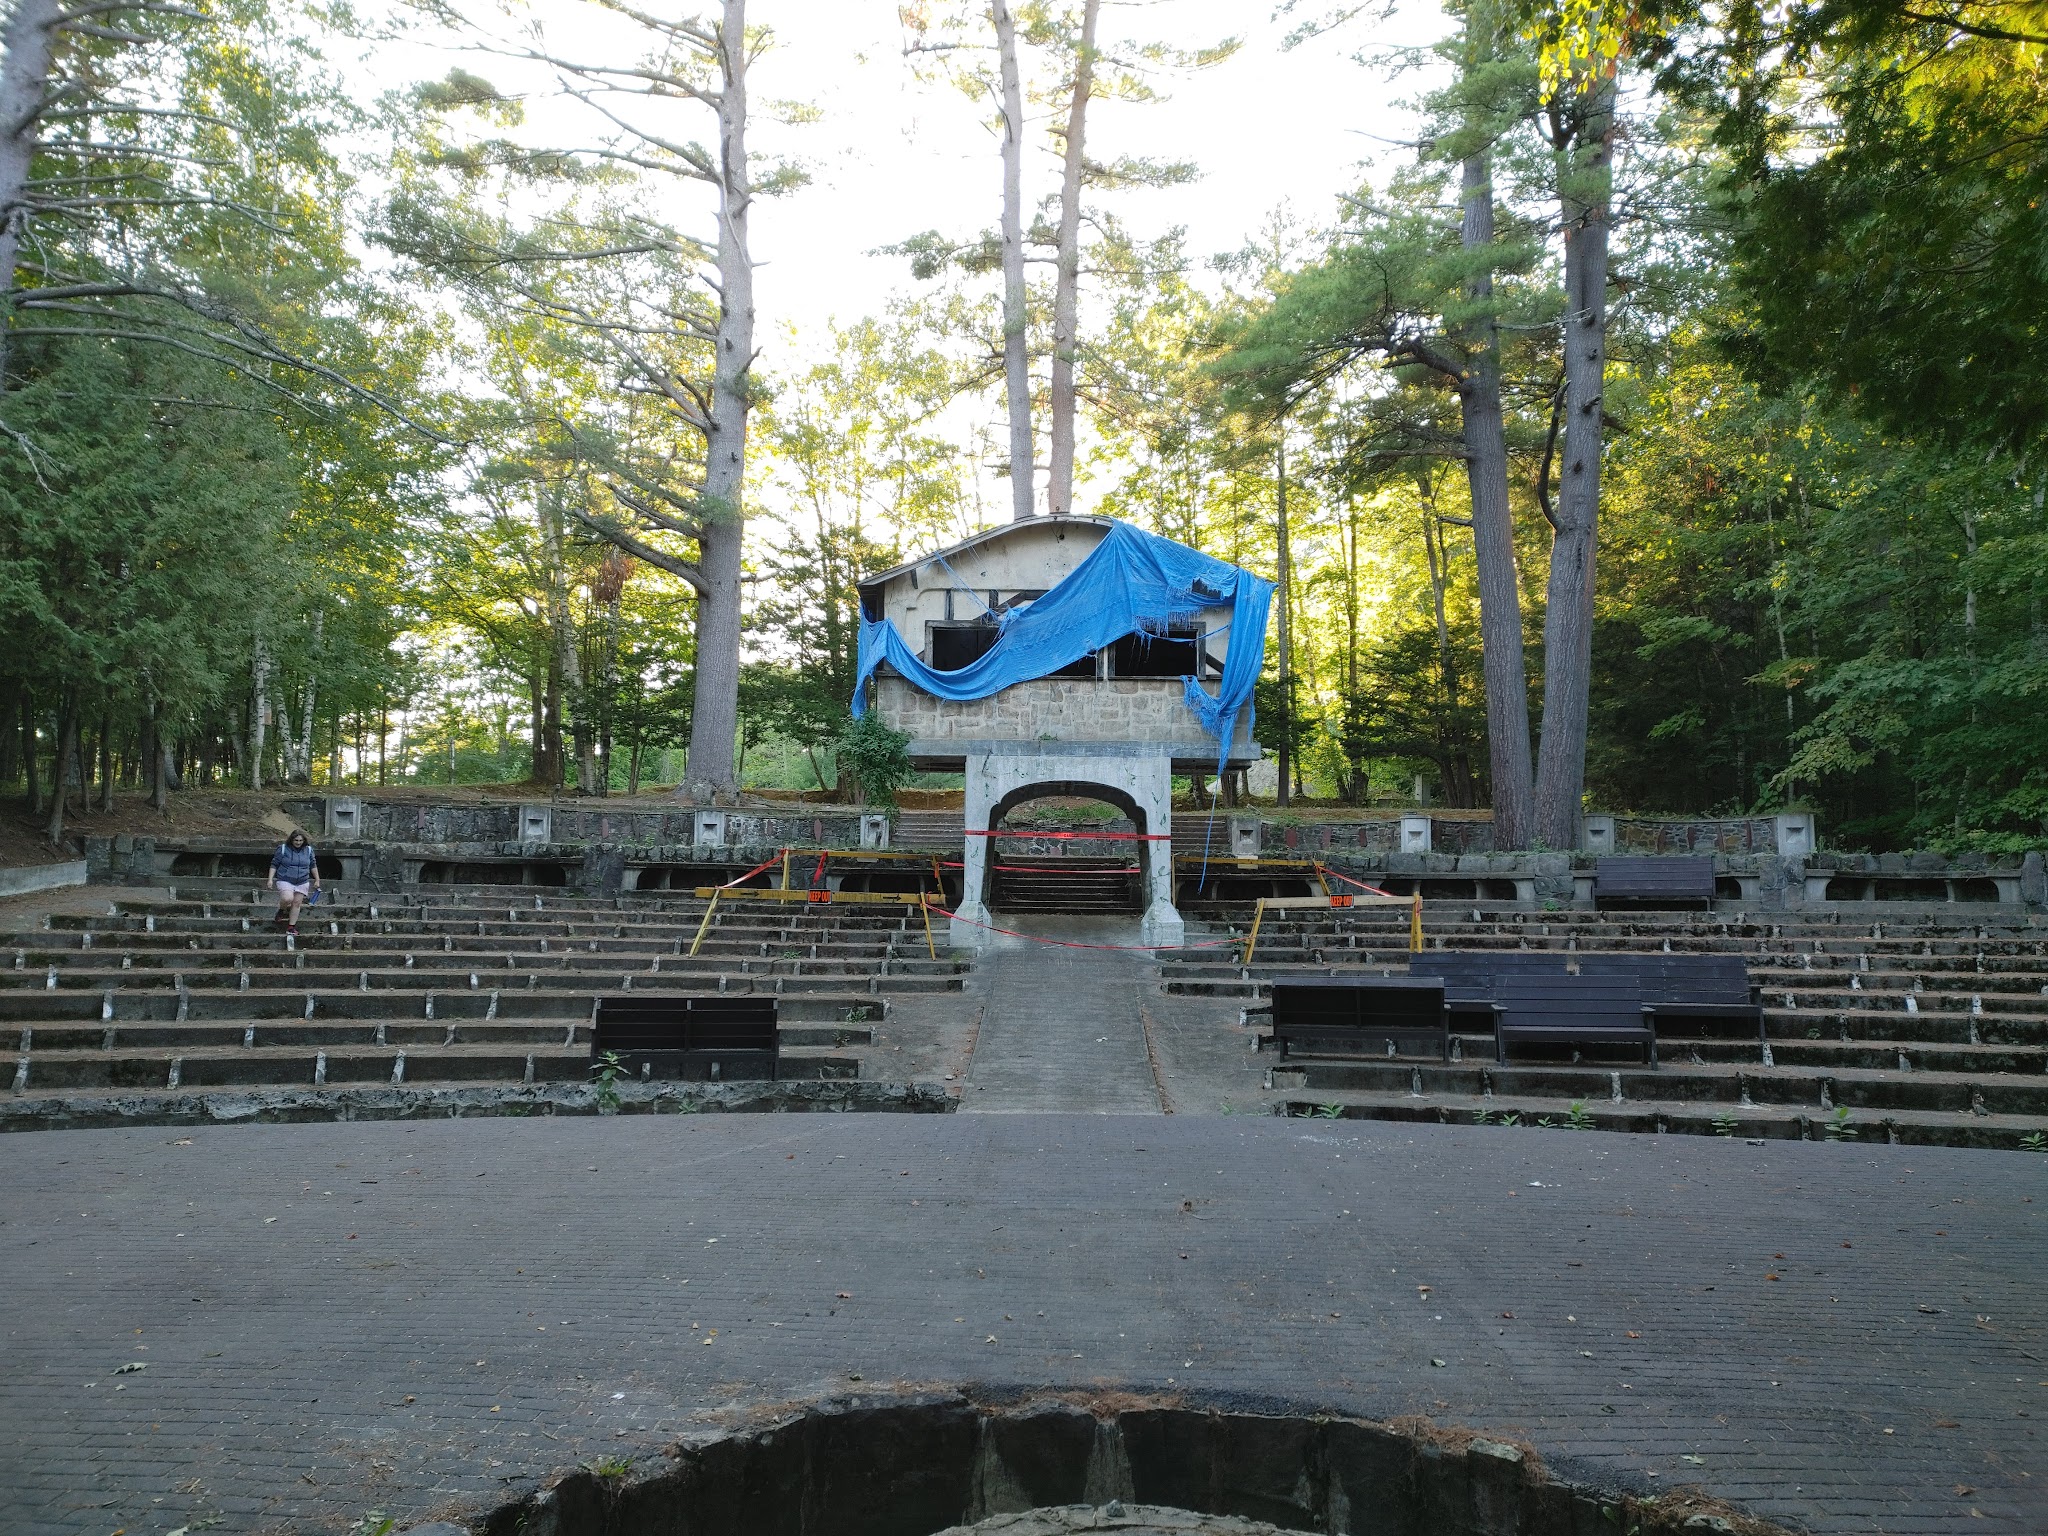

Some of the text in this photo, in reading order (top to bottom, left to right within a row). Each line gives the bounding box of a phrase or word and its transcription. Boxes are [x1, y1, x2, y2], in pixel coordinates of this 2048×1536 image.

[809, 890, 831, 902] KEEP OUT
[1330, 895, 1353, 907] KEEP OUT
